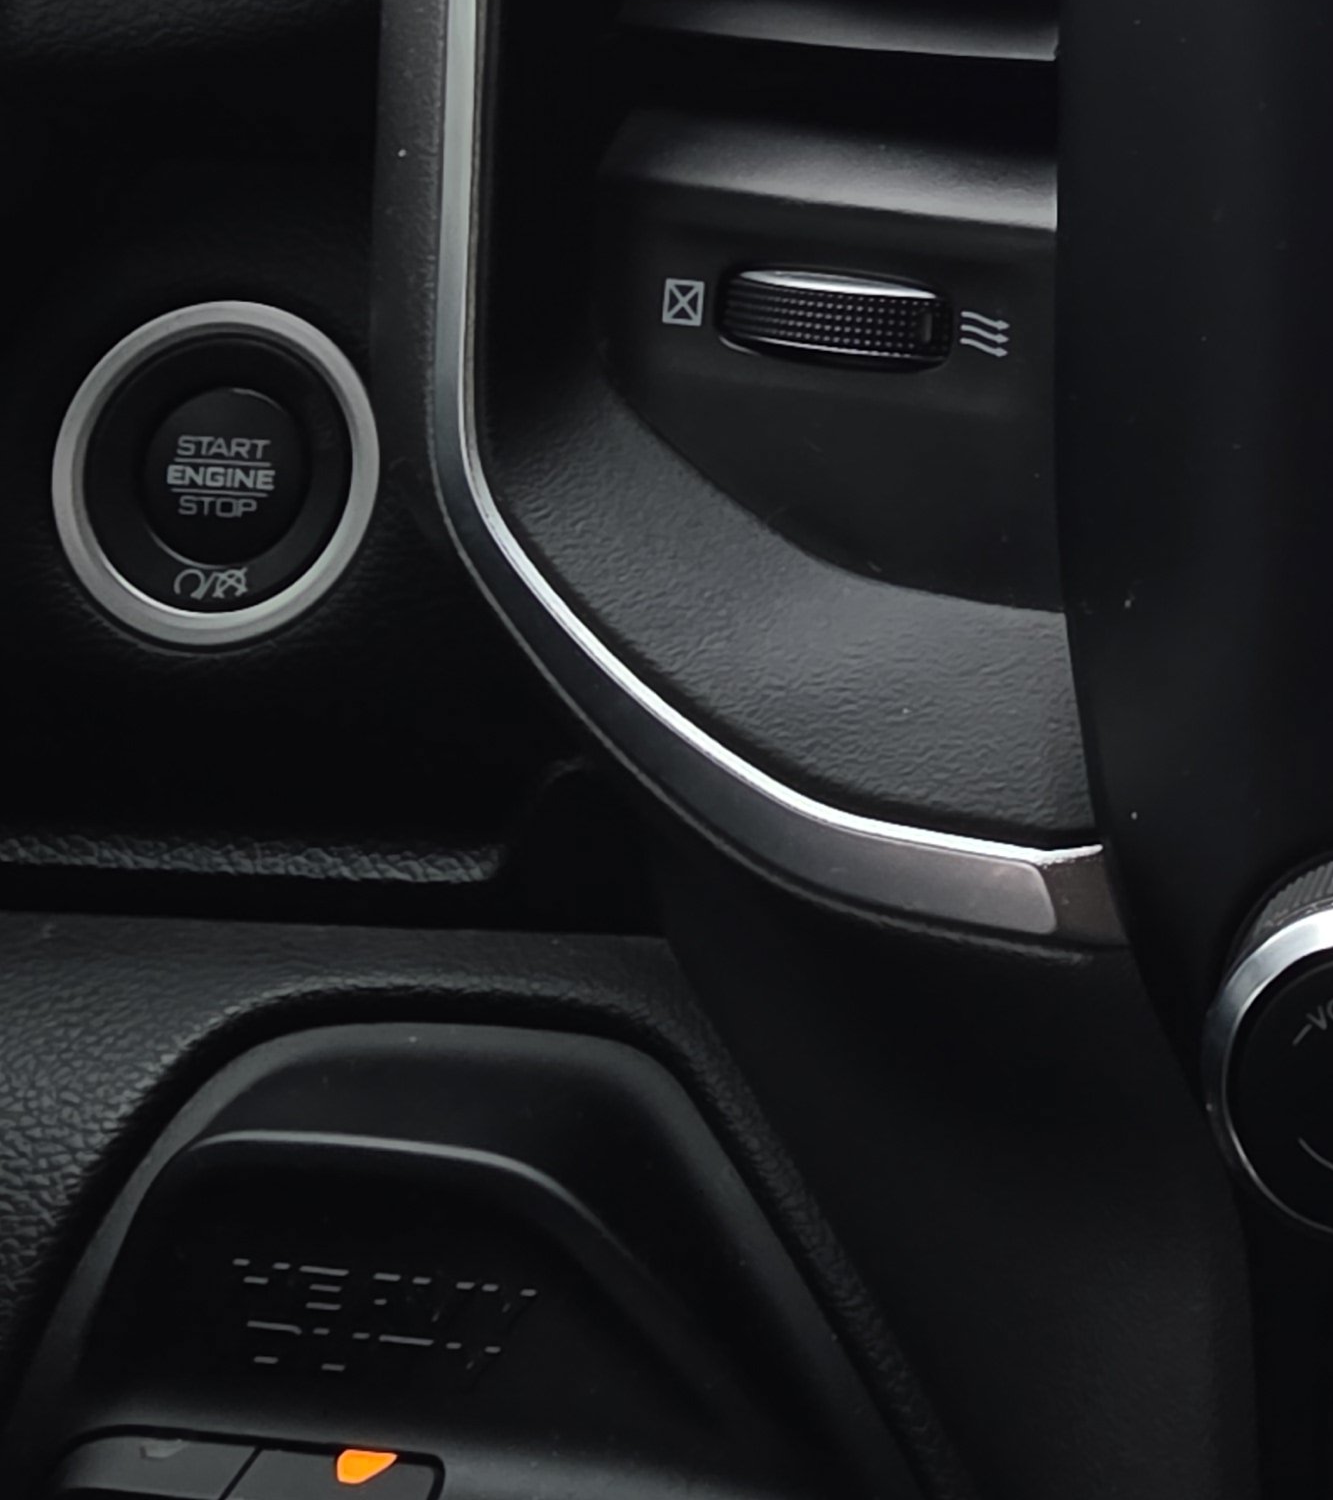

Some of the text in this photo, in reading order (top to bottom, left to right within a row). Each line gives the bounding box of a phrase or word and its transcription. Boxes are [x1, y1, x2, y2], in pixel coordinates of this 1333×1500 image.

[177, 436, 270, 460] START
[166, 464, 275, 491] ENGINE
[178, 494, 257, 518] STOP
